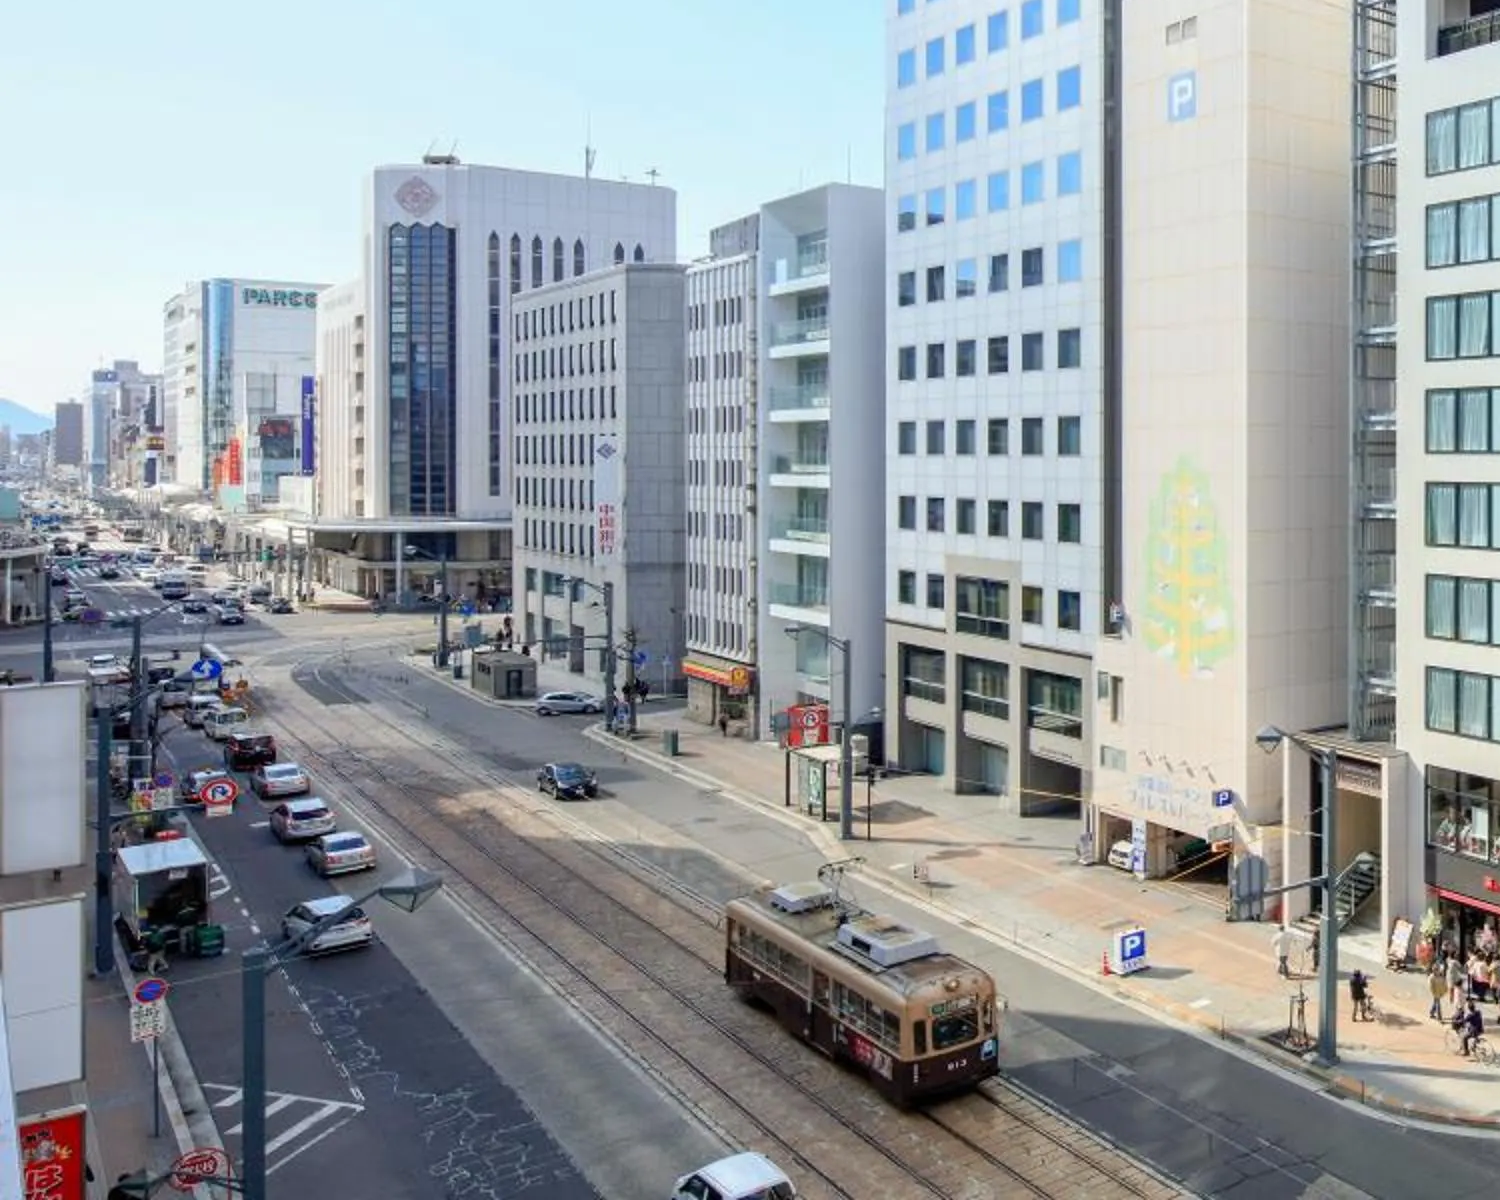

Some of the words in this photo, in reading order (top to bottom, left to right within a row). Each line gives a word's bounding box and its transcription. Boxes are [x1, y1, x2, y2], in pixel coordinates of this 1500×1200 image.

[1173, 79, 1192, 117] P
[1219, 791, 1229, 805] P
[1123, 935, 1141, 958] P
